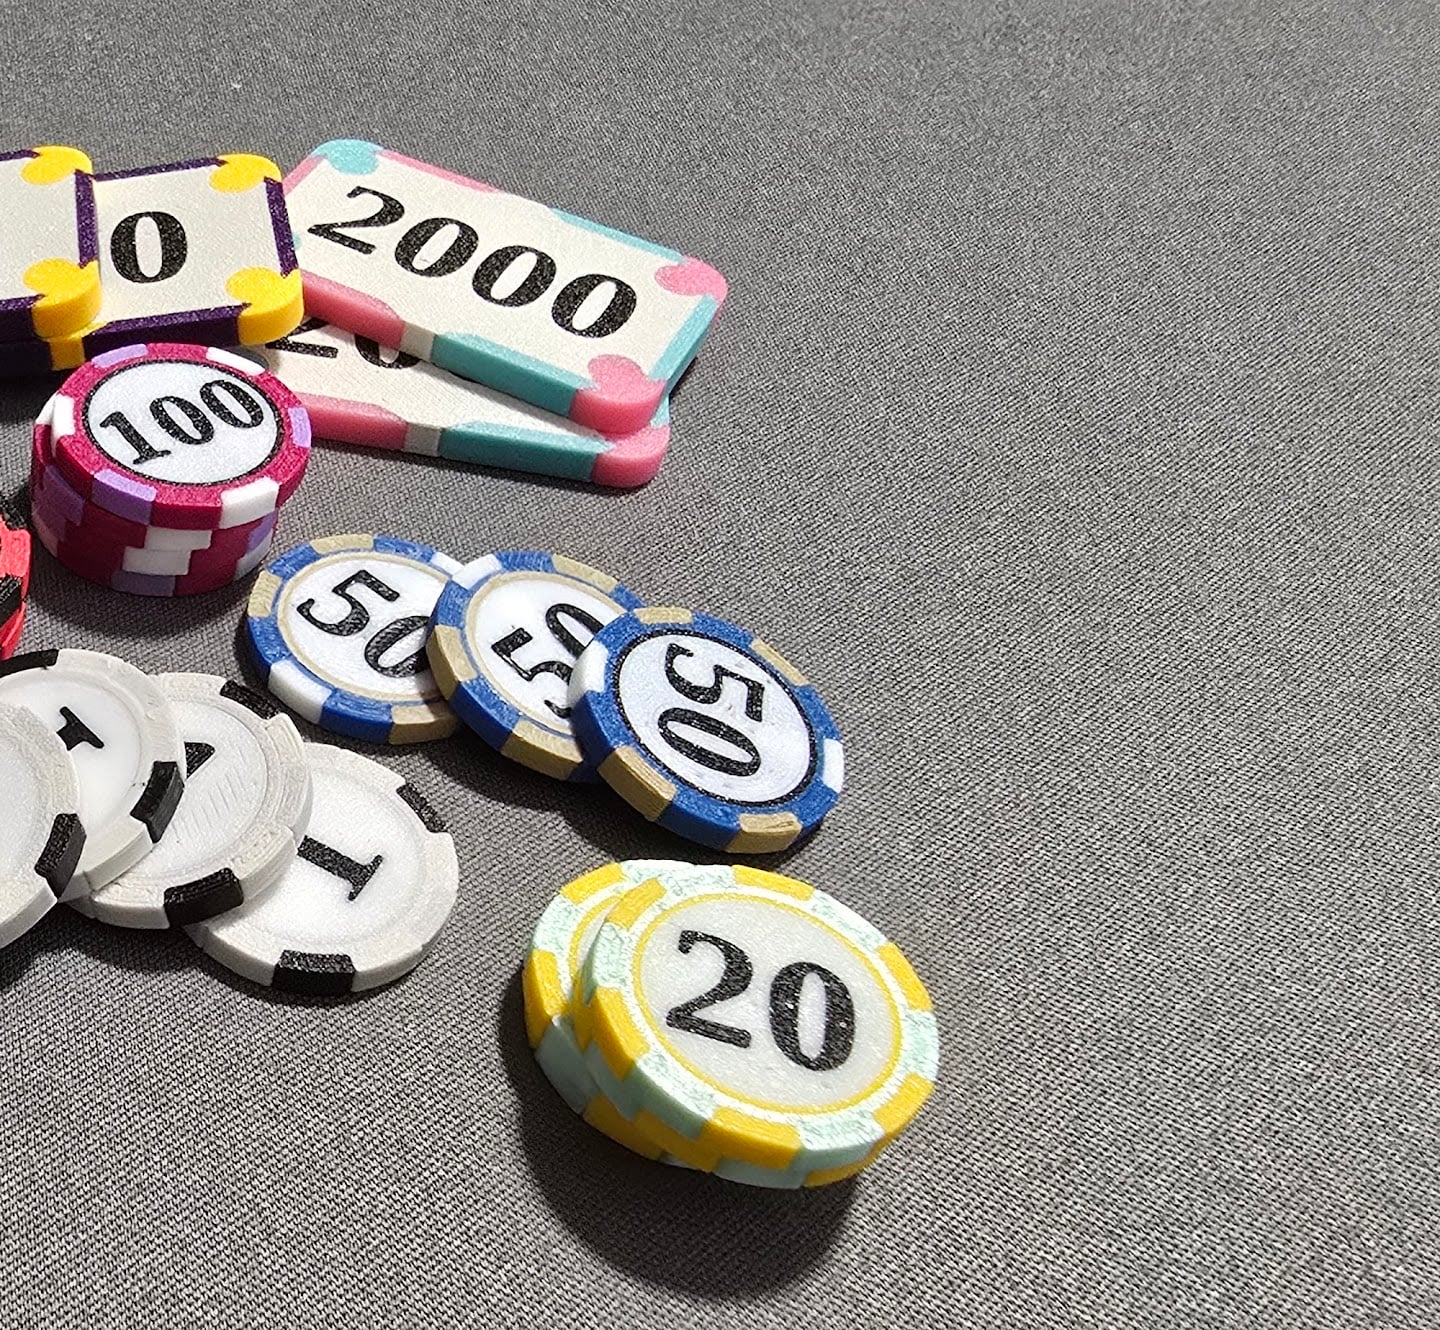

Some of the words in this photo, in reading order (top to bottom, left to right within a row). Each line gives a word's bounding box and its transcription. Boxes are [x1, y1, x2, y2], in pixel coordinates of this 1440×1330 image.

[308, 186, 639, 339] 2000
[98, 378, 265, 466] 100
[297, 569, 432, 678] 50
[657, 643, 766, 778] 50
[666, 930, 856, 1072] 20
